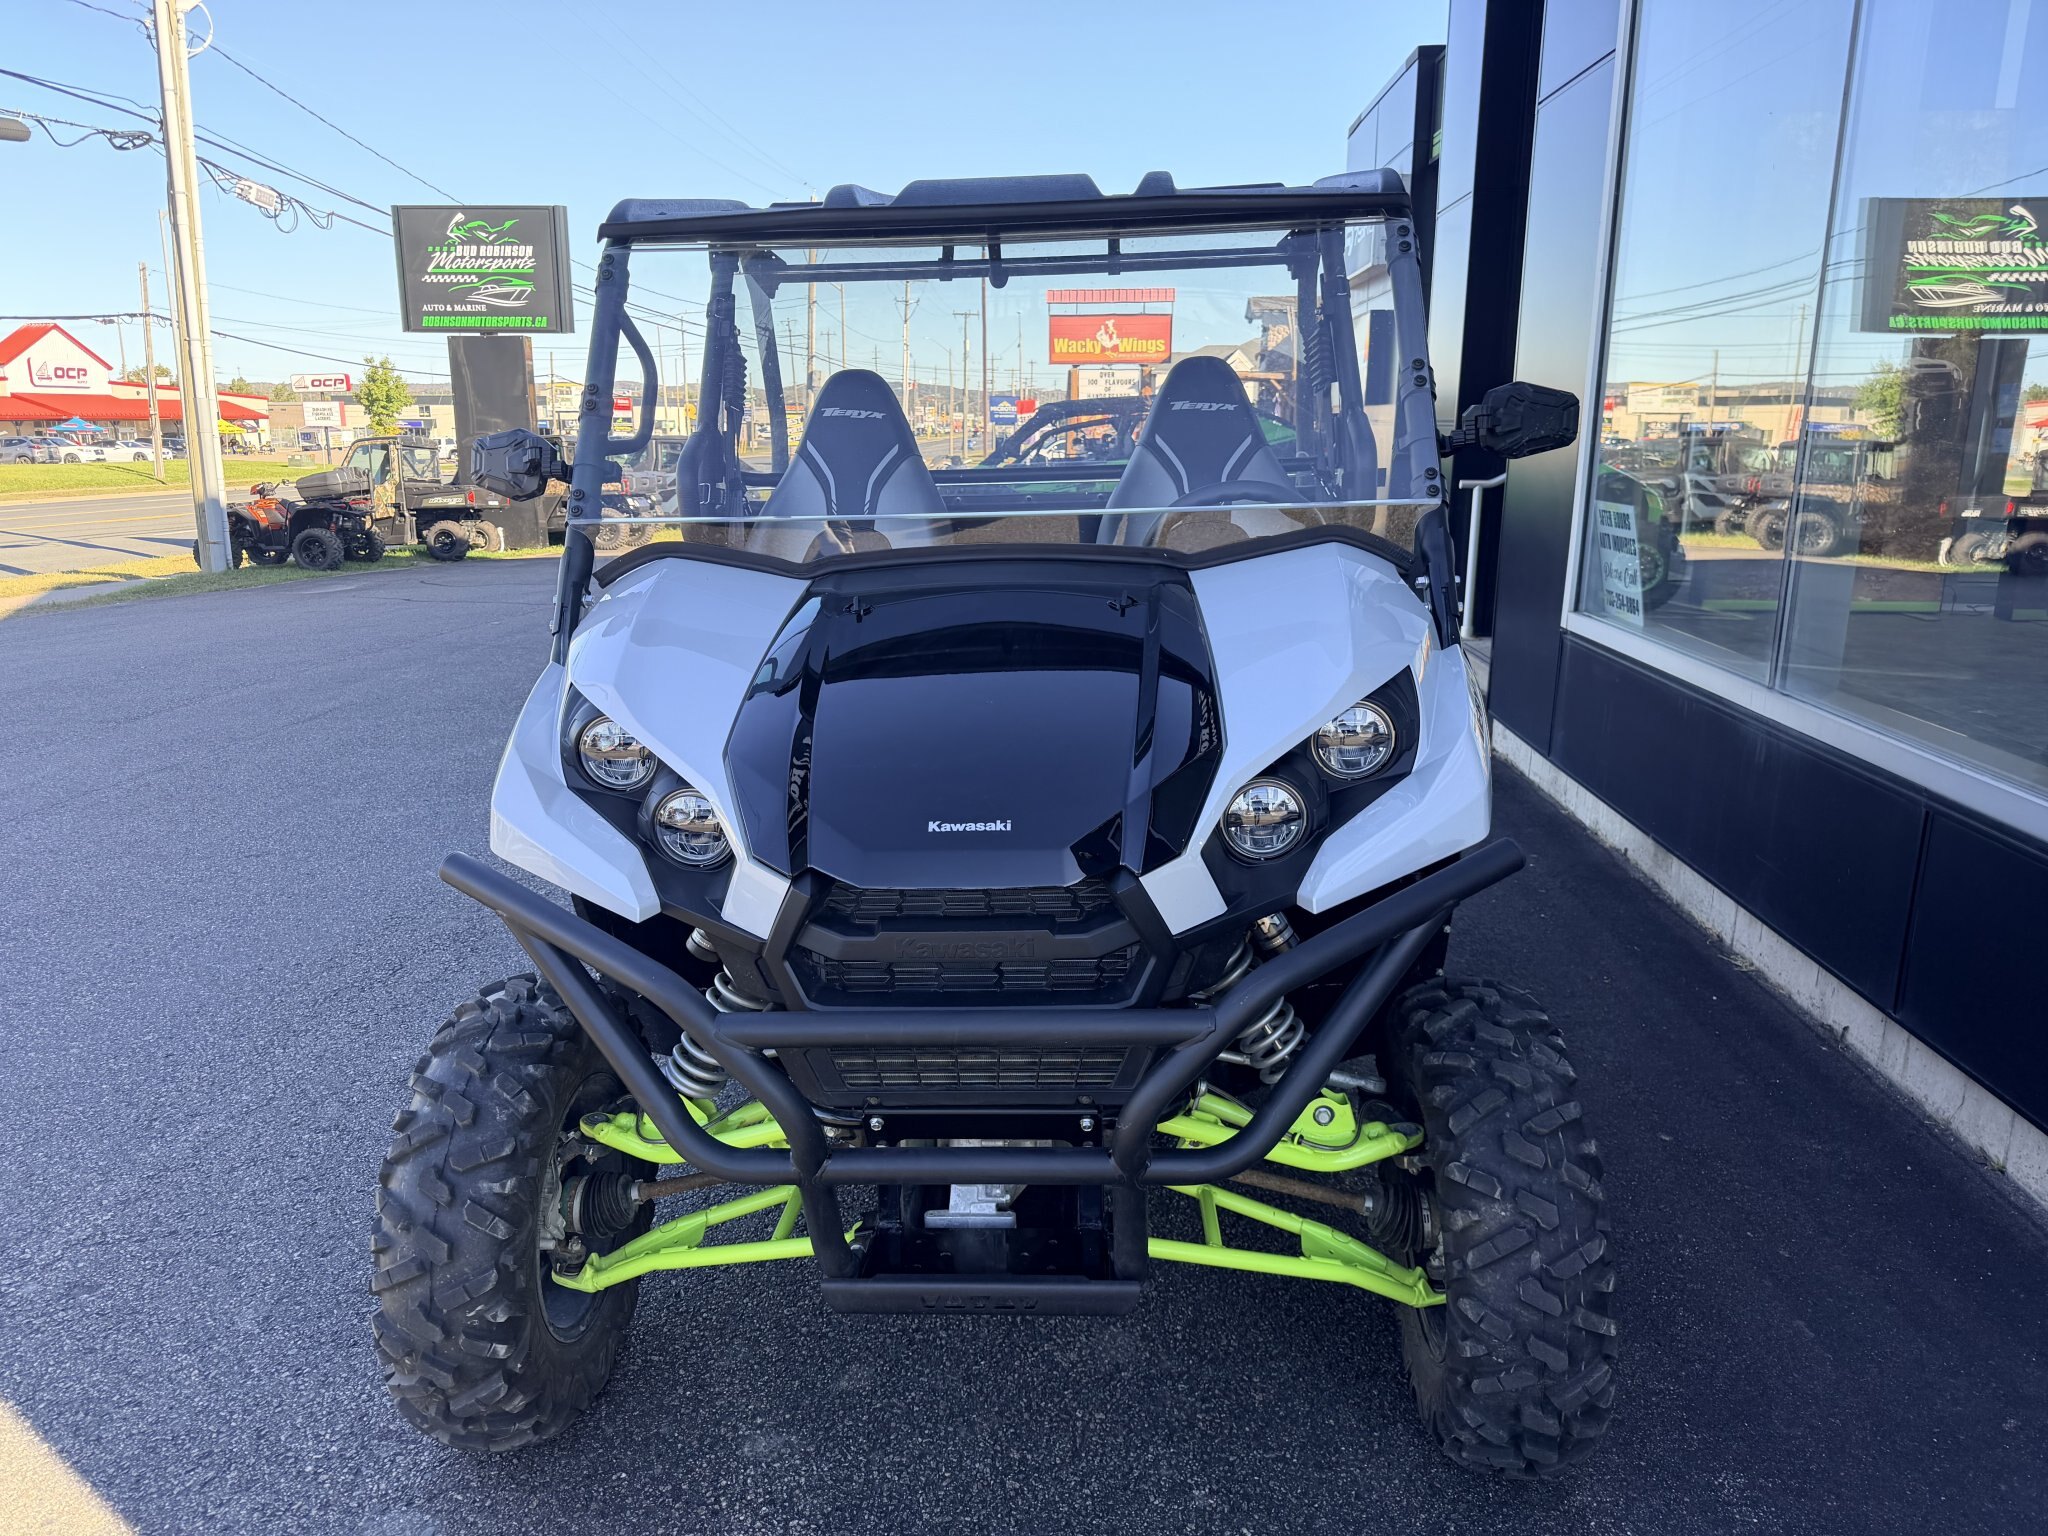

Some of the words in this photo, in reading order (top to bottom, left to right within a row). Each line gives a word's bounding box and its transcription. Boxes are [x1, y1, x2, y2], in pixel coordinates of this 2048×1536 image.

[455, 245, 477, 257] BUD
[479, 245, 534, 257] ROBINSON
[427, 250, 537, 273] Motorsports
[422, 304, 445, 312] AUTO
[446, 304, 453, 312] &
[454, 304, 487, 312] MARINE
[422, 316, 548, 328] ROBINSONMOTORSPORTS.CA
[1053, 337, 1102, 354] Wacky
[1118, 337, 1166, 353] Wings
[55, 367, 87, 379] OCP
[311, 379, 344, 387] OCP
[1105, 378, 1136, 386] FLAVOURS
[1623, 567, 1638, 589] Call
[927, 819, 1012, 833] Kawasaki
[897, 937, 1034, 958] Kawasaki
